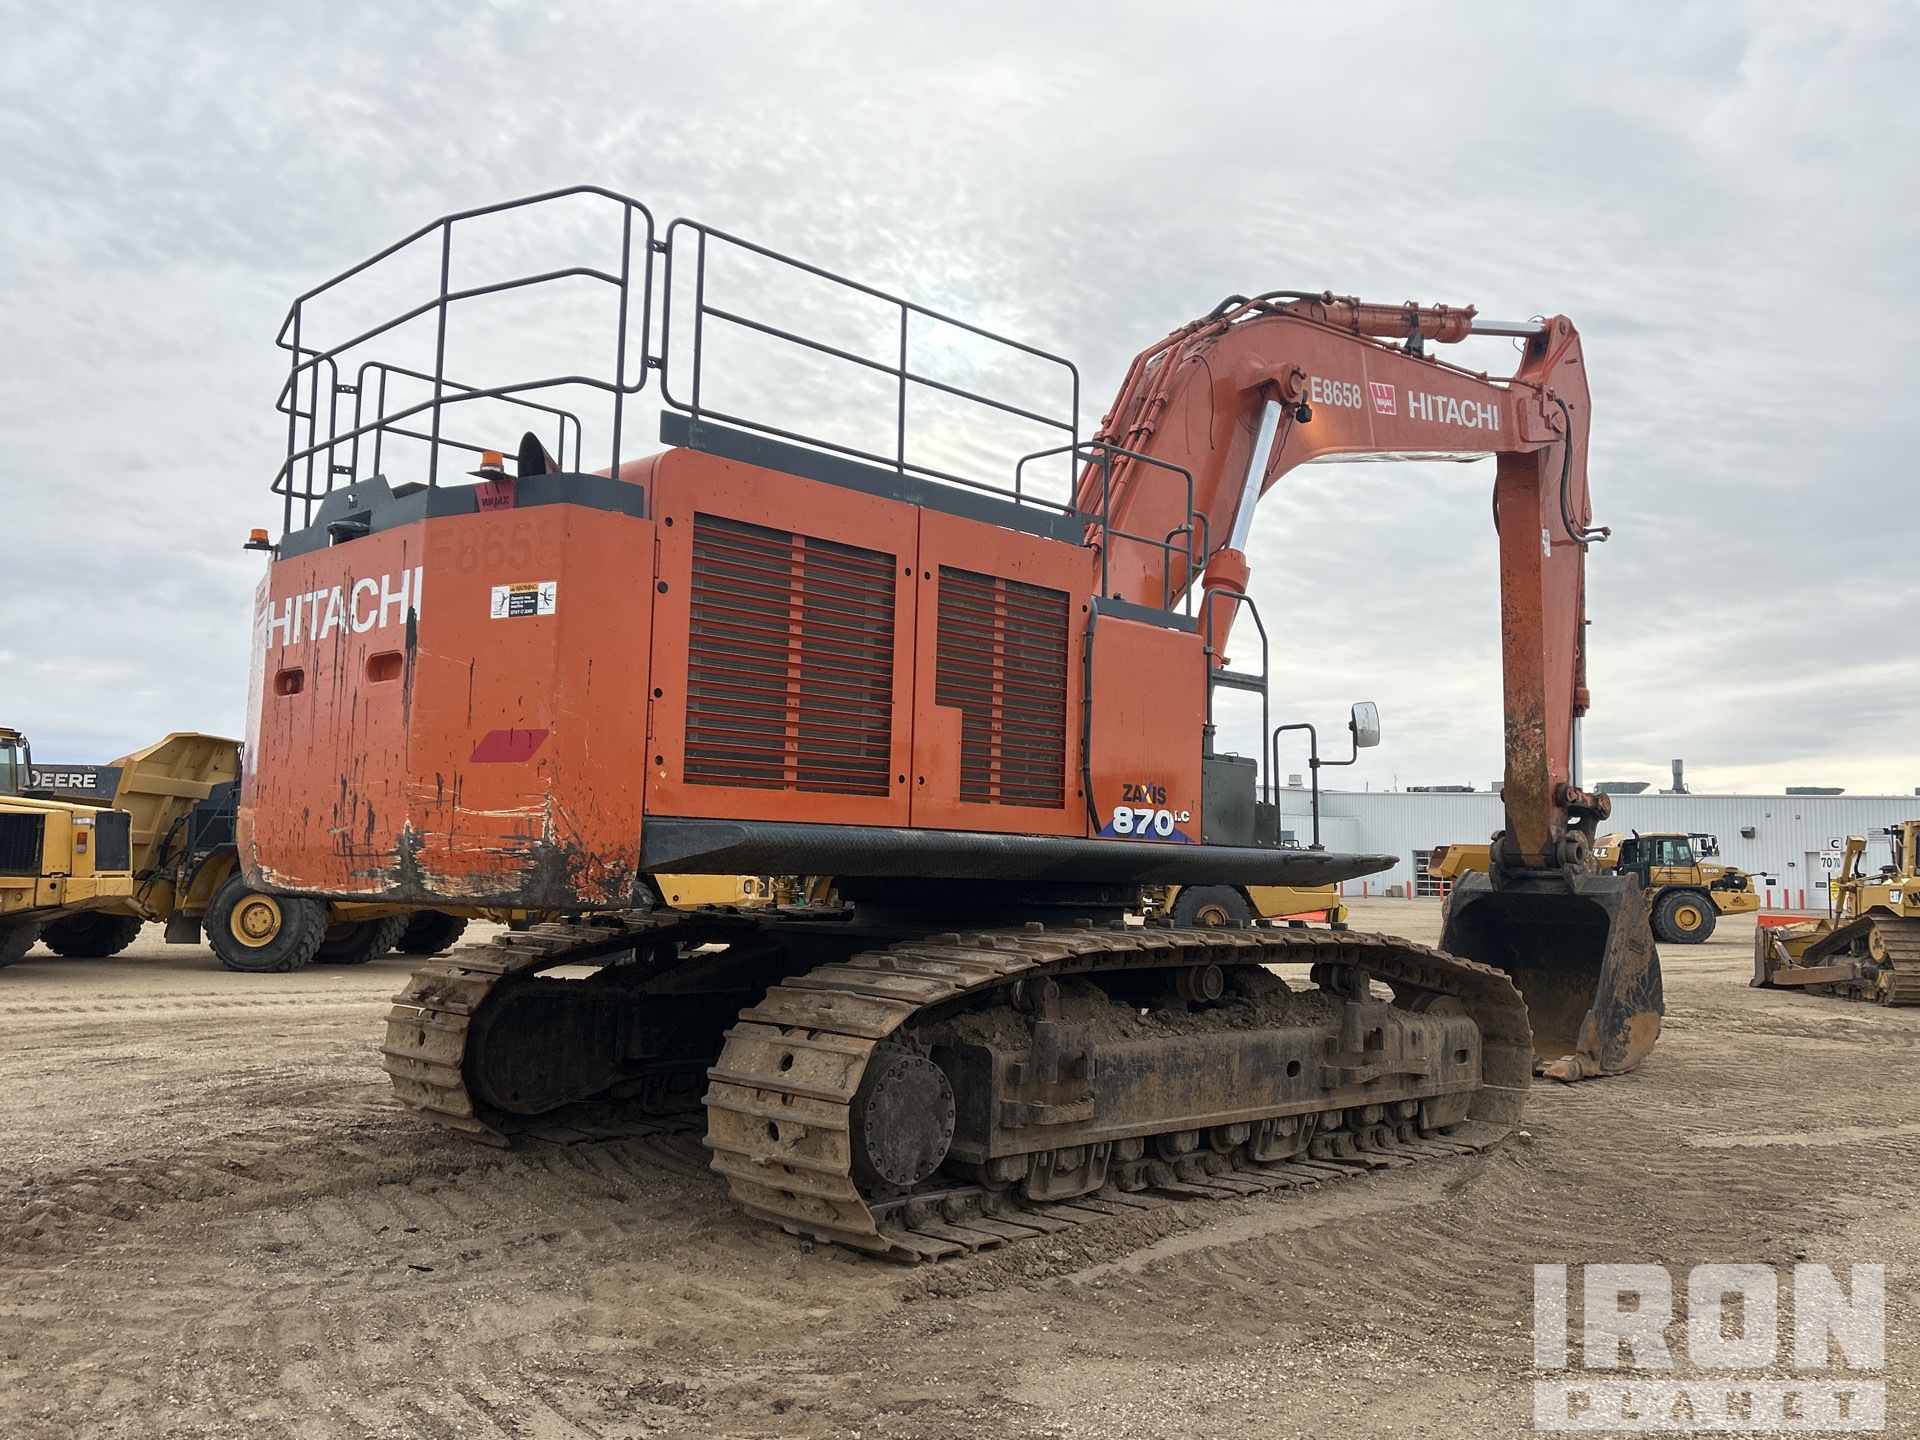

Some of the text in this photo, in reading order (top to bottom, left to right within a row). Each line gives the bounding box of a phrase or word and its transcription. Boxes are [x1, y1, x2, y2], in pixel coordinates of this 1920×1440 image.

[1310, 376, 1362, 409] E8658
[1408, 390, 1499, 431] HITACHI
[515, 583, 538, 591] WARNING
[266, 566, 424, 649] HITACHI
[32, 770, 97, 788] DEERE
[1122, 780, 1167, 805] ZAXIS
[1830, 839, 1840, 849] C
[1821, 857, 1833, 868] 70
[1833, 857, 1841, 868] 70
